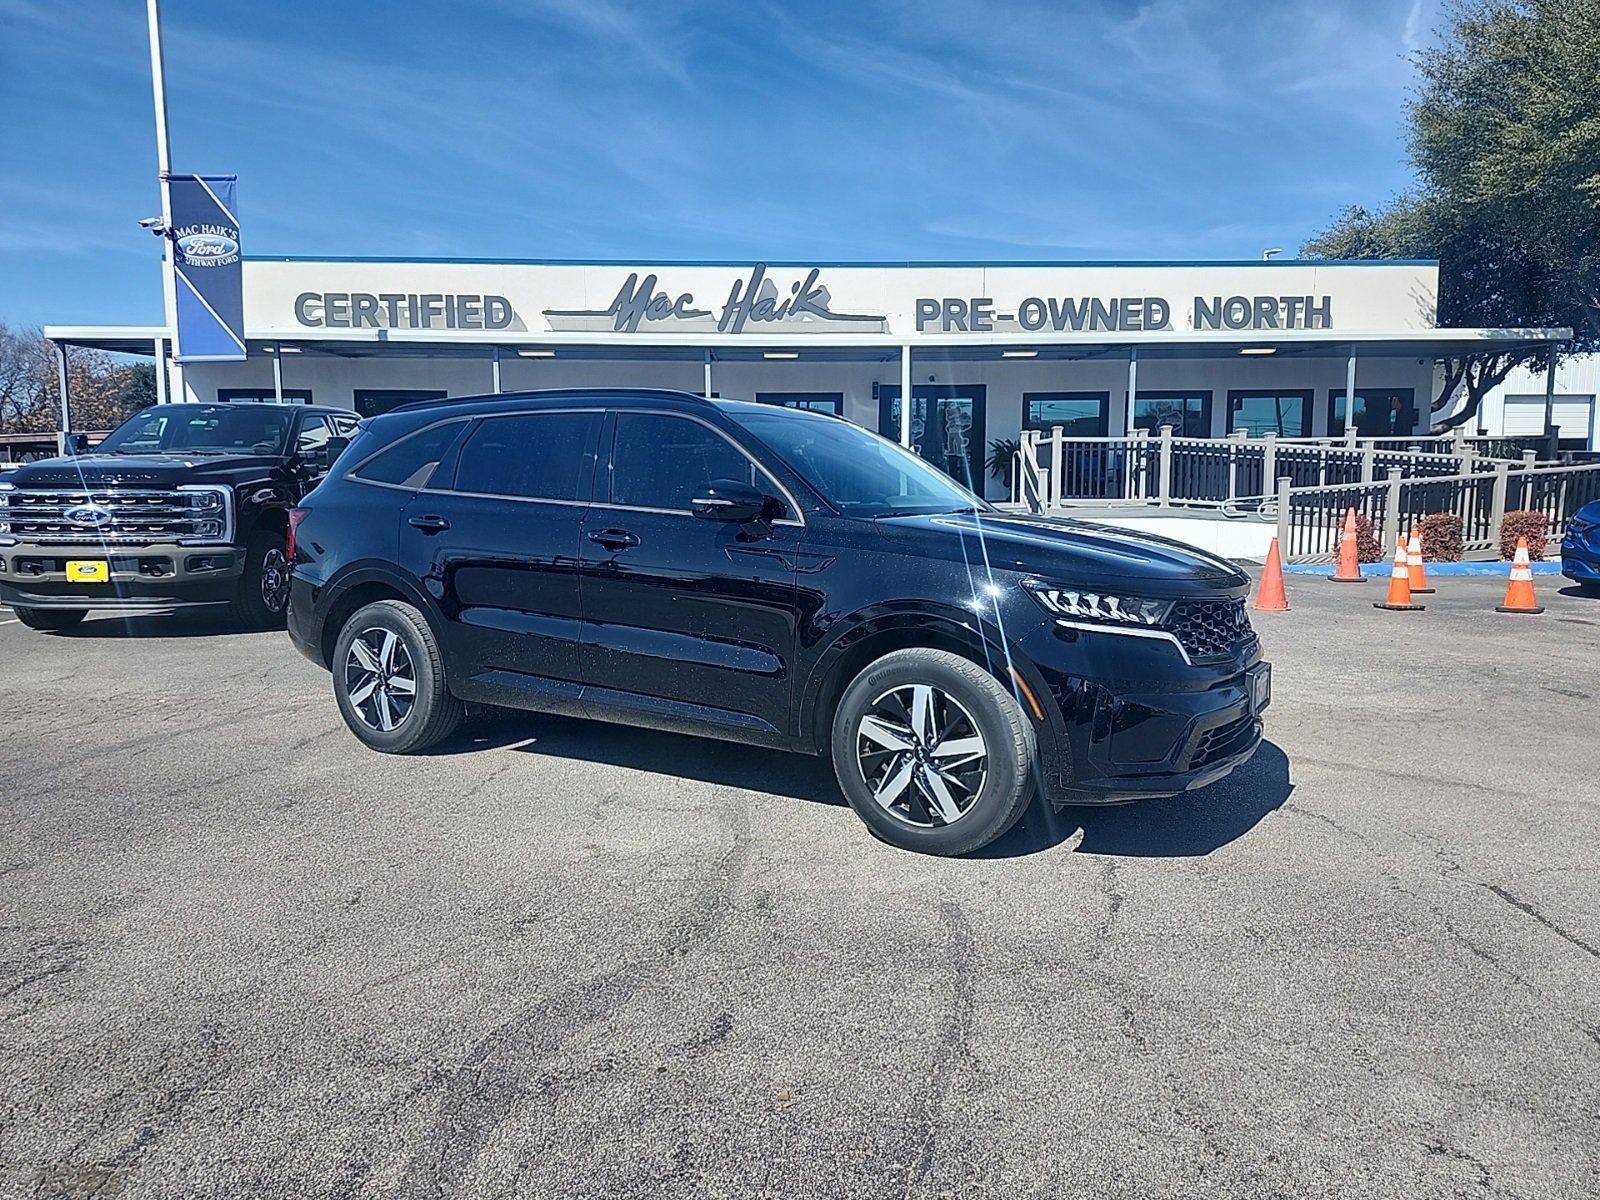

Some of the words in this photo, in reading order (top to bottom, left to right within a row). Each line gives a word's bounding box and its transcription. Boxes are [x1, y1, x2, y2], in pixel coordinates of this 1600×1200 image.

[174, 225, 198, 239] MAC
[201, 224, 238, 240] HAIK'S
[186, 238, 226, 255] Ford
[175, 256, 217, 266] UTHWAY
[217, 255, 239, 266] FORD
[294, 292, 513, 329] CERTIFIED
[542, 272, 712, 333] Mac
[717, 261, 886, 334] Haik
[915, 297, 1170, 332] PRE-OWNED
[1193, 295, 1332, 329] NORTH
